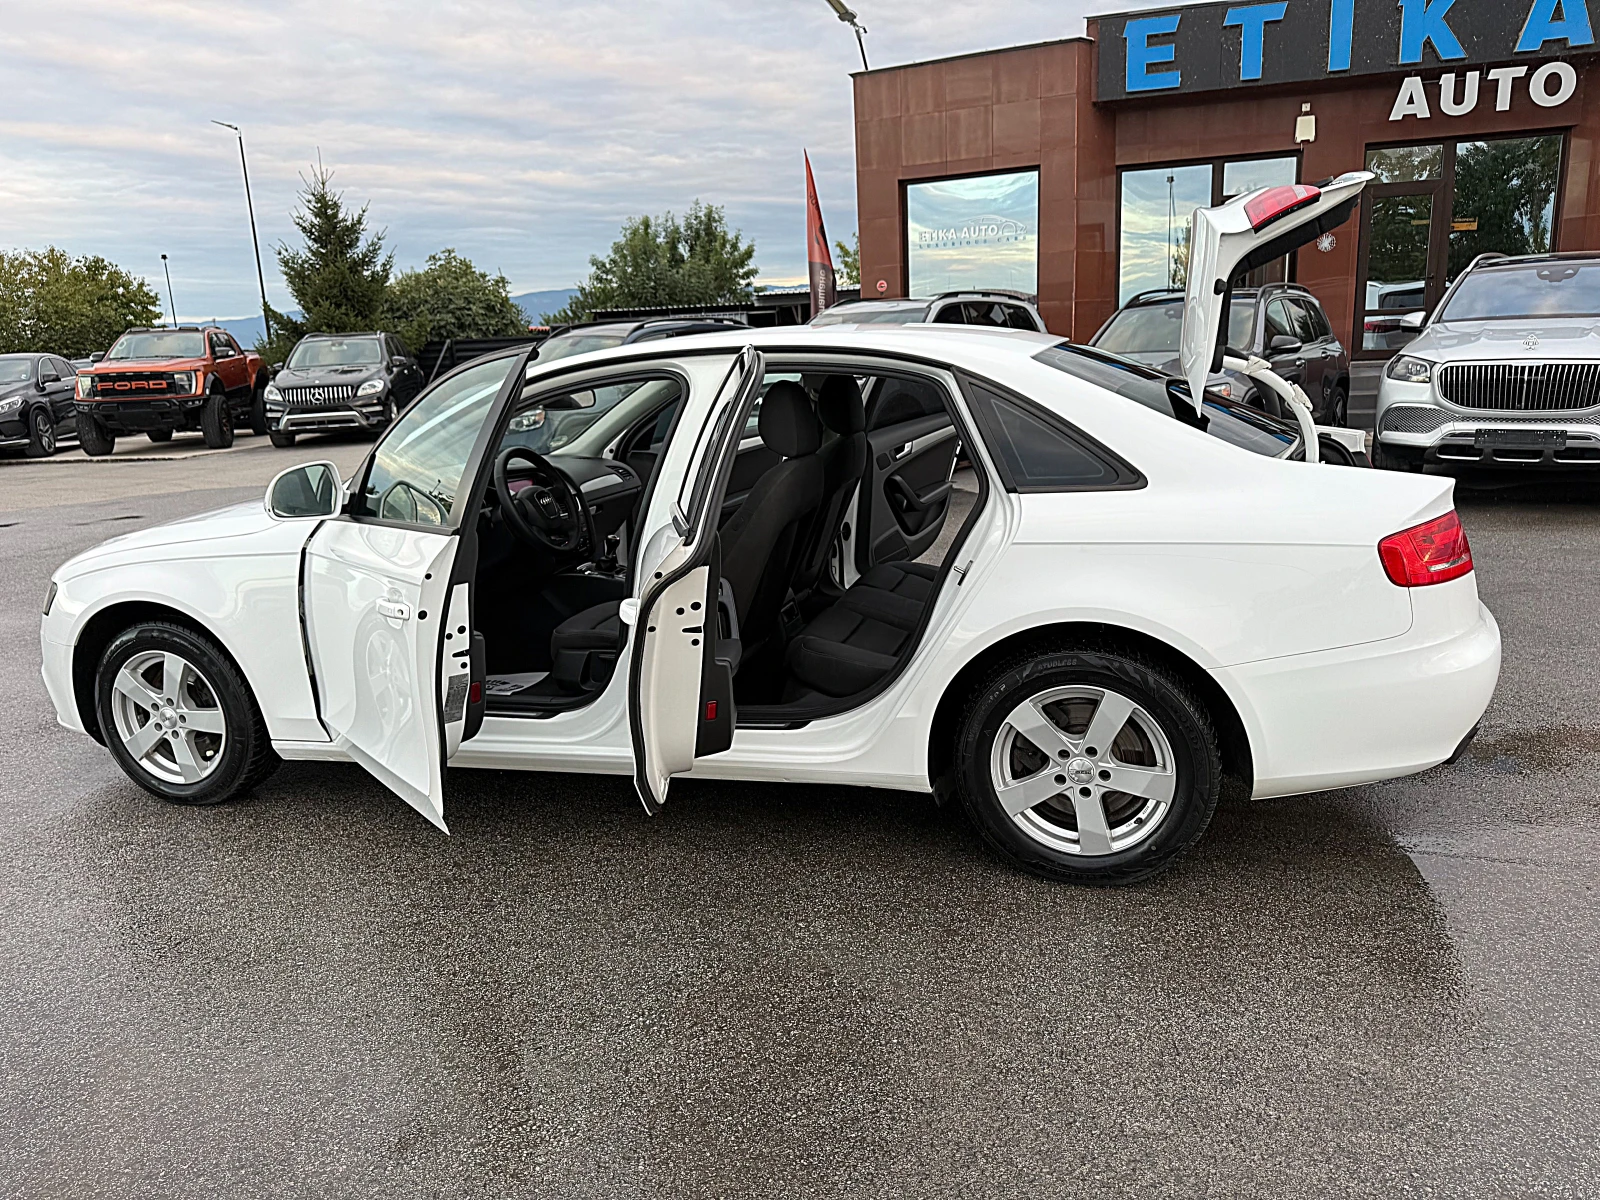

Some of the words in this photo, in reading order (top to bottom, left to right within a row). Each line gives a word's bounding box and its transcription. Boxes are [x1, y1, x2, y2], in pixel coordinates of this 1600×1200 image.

[1123, 0, 1595, 92] ETIKA
[1388, 61, 1577, 121] AUTO
[919, 228, 957, 242] ETIKA
[961, 224, 999, 239] AUTO
[97, 380, 167, 391] FORD
